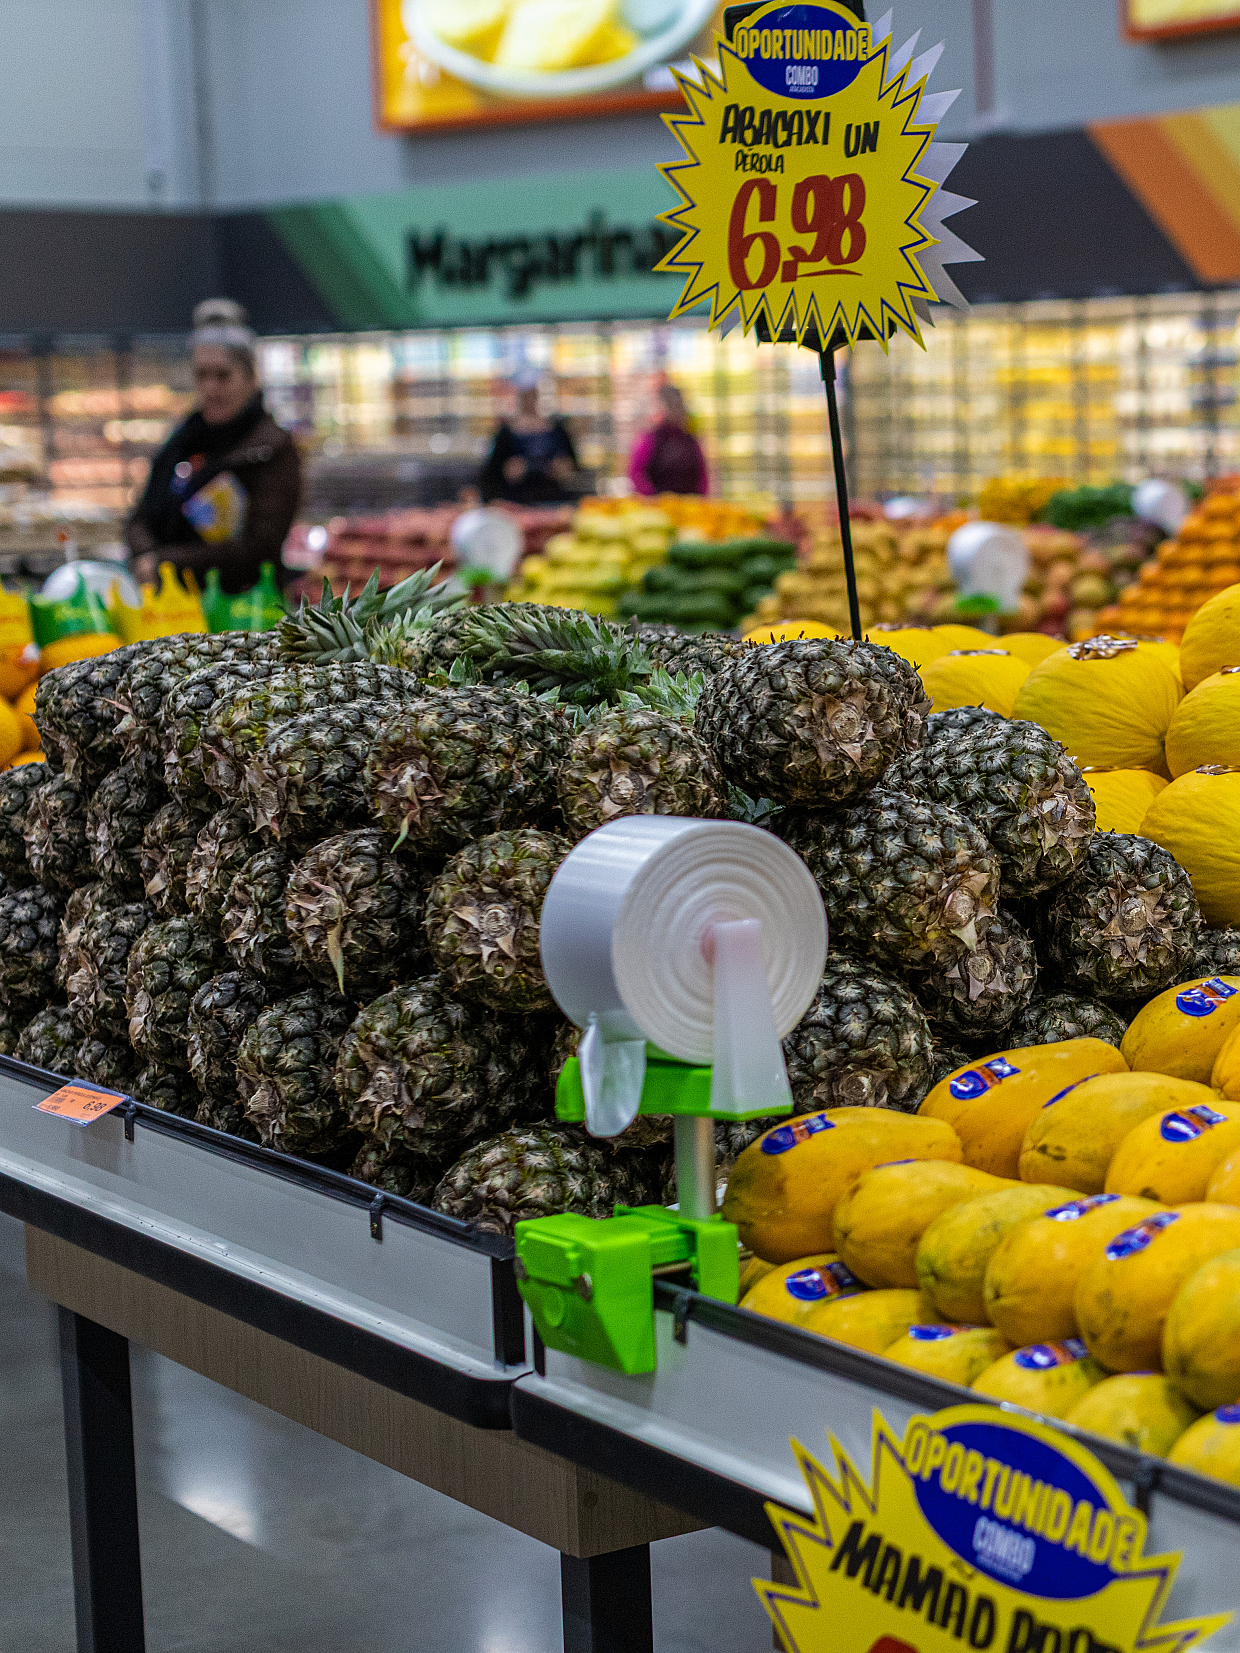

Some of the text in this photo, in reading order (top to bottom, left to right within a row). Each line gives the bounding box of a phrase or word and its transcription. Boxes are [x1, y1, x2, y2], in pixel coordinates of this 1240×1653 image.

[736, 27, 868, 61] OPORTUNIDADE
[786, 65, 819, 86] COMBO
[718, 103, 880, 158] ABACAXI UN
[904, 1422, 1136, 1574] OPORTUNIDADE
